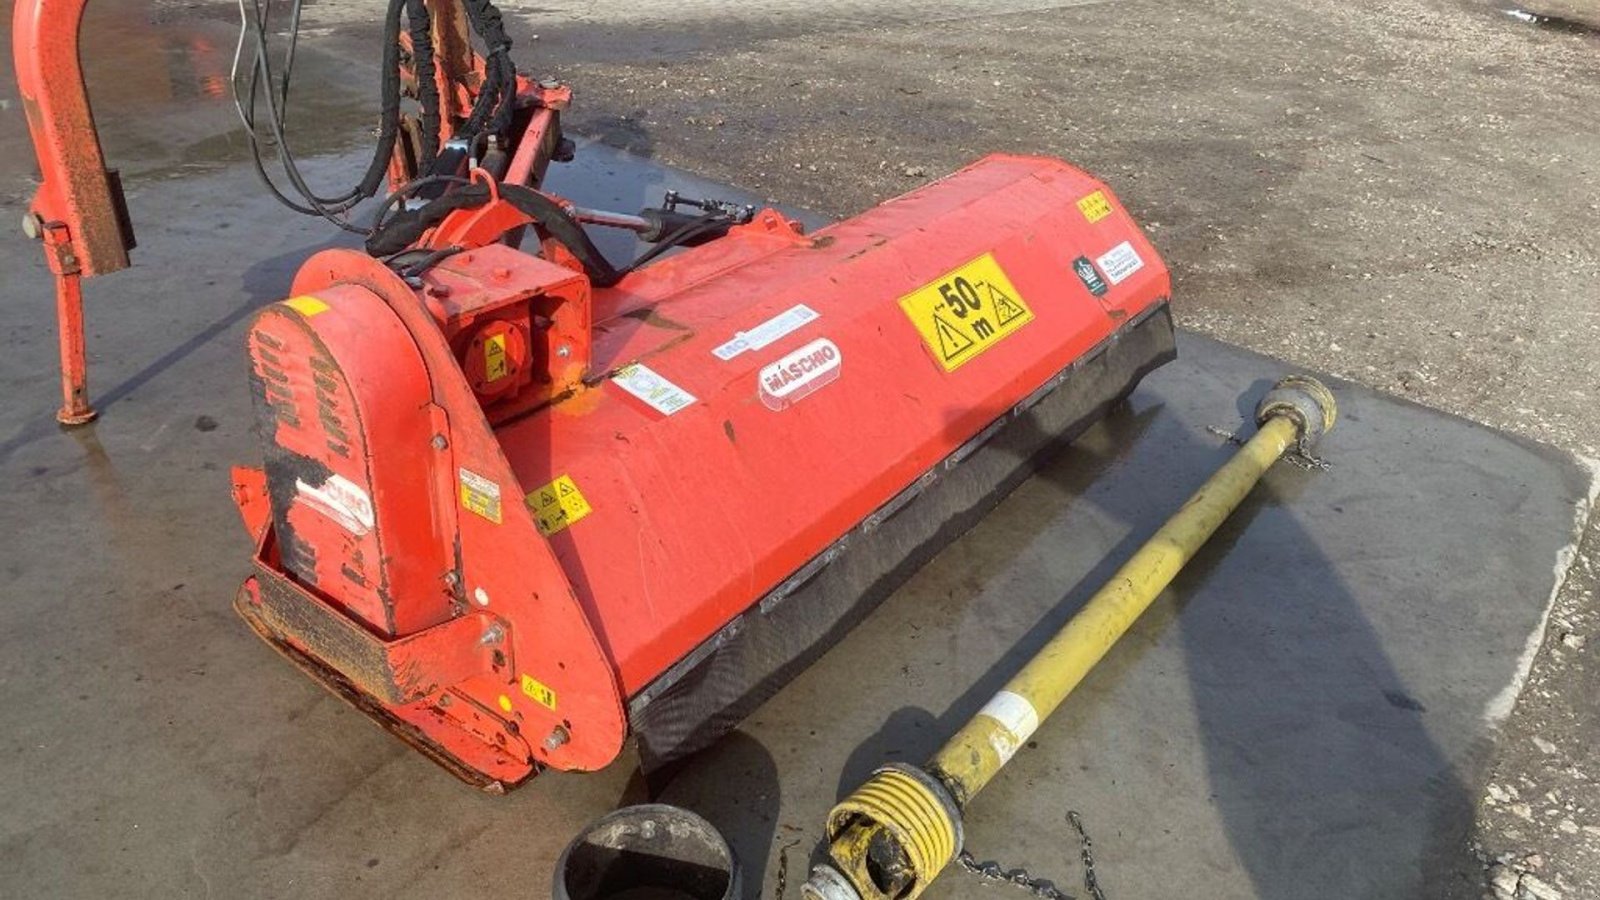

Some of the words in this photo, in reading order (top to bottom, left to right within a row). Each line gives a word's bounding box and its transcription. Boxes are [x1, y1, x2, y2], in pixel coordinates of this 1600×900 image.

[938, 276, 981, 319] 50
[971, 317, 995, 340] m
[764, 345, 836, 392] MASCHIO
